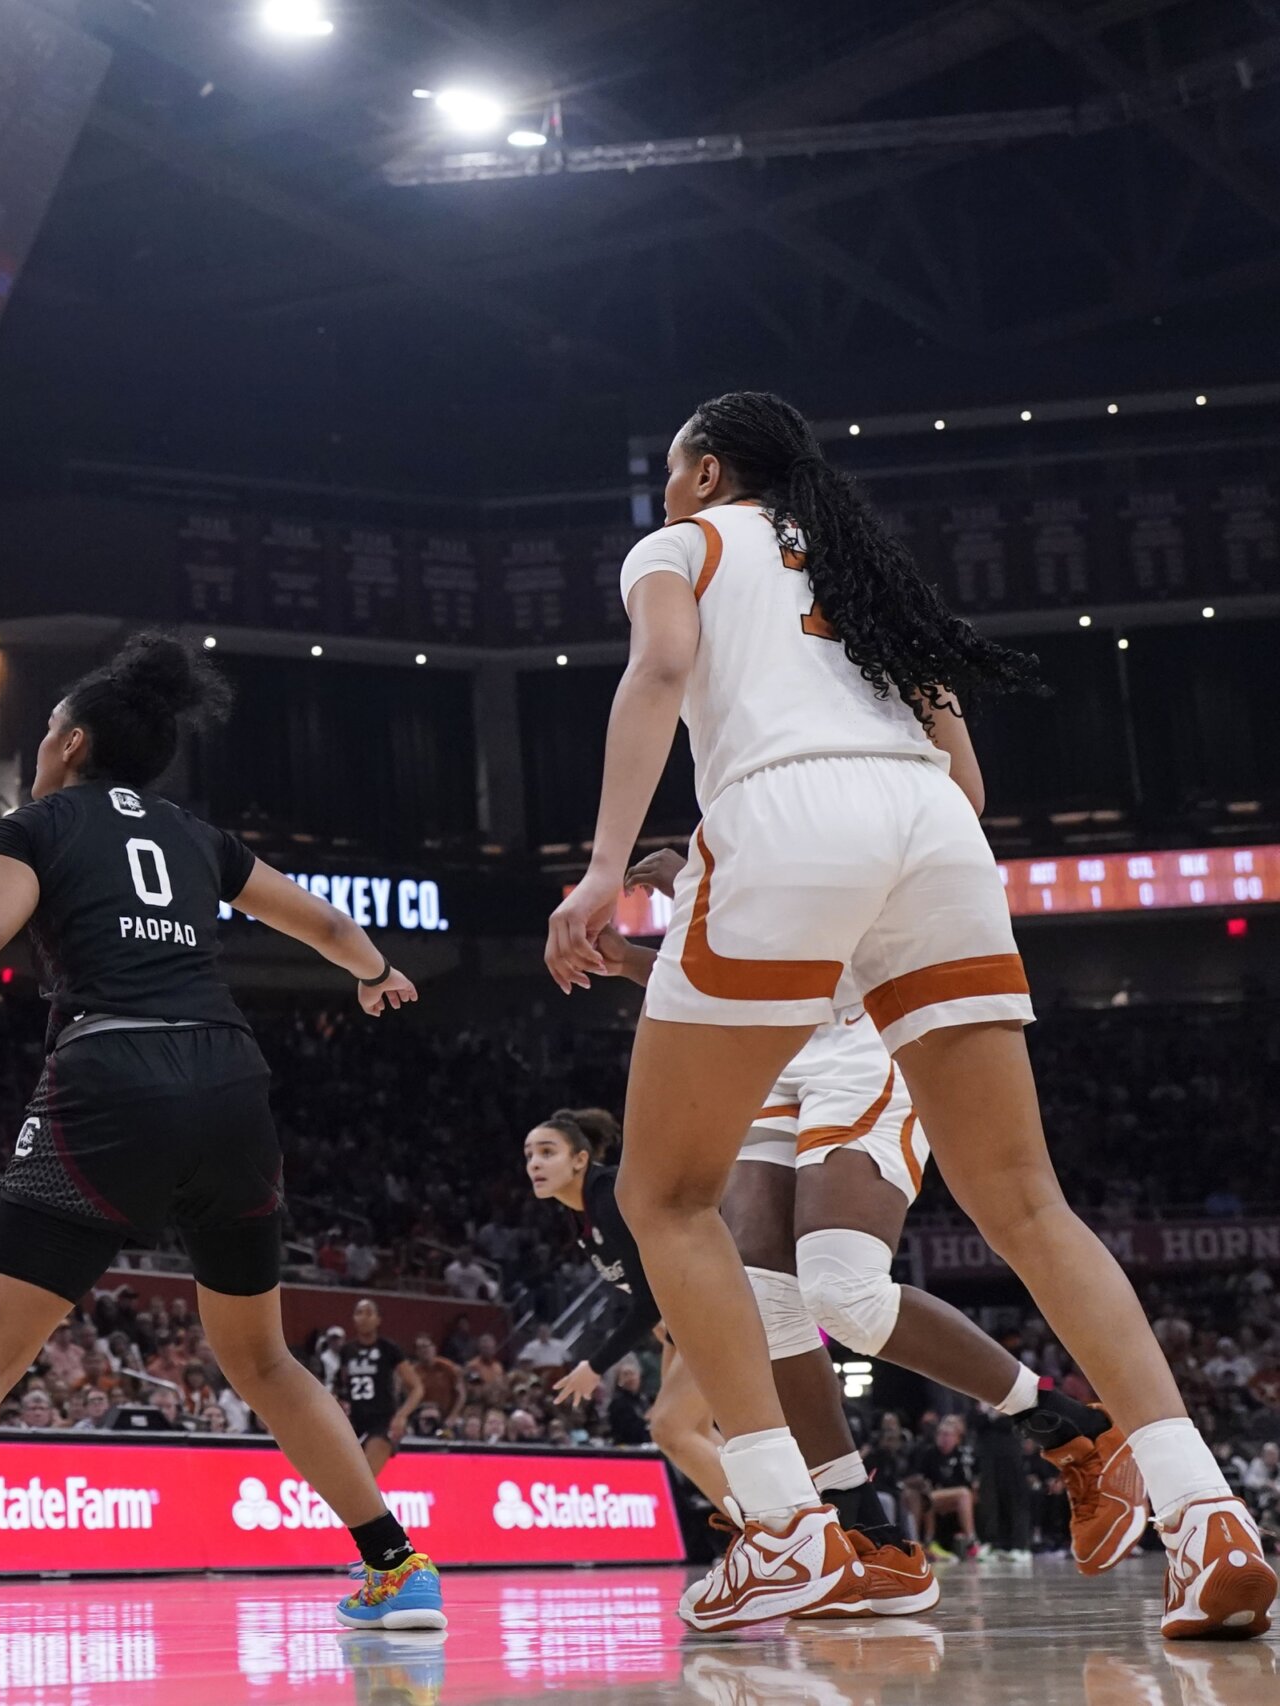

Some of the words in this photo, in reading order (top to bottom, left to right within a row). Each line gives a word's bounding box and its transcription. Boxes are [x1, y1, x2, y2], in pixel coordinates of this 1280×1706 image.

[126, 837, 173, 907] 0
[397, 879, 449, 931] CO.
[119, 916, 197, 947] PAOPAO
[349, 1375, 376, 1401] 23
